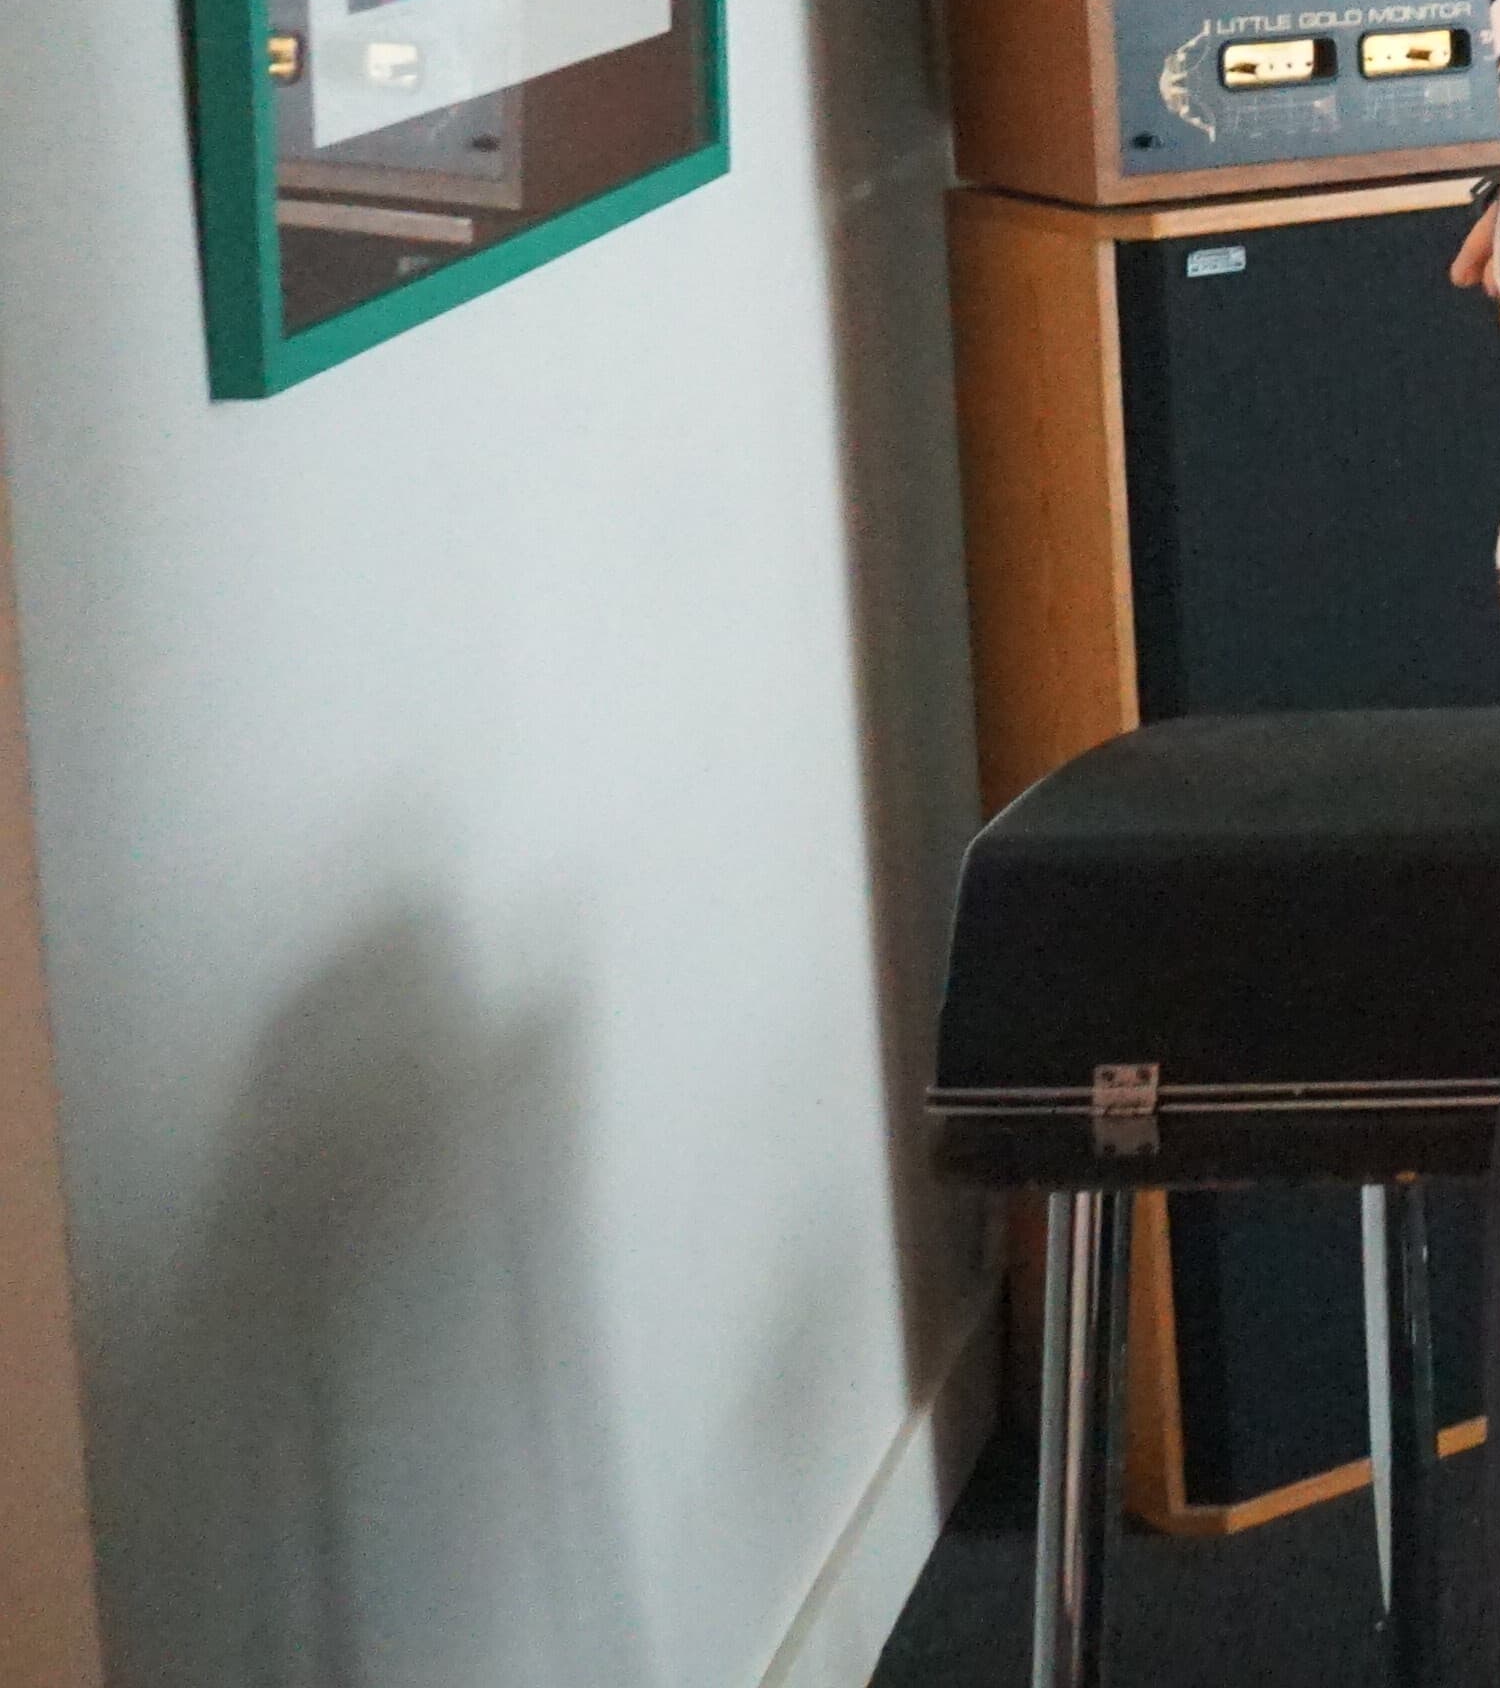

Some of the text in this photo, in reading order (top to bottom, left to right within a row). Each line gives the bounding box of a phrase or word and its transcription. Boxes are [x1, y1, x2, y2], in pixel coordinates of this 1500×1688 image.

[1217, 1, 1472, 35] LITTLE GOLD MONITOR
